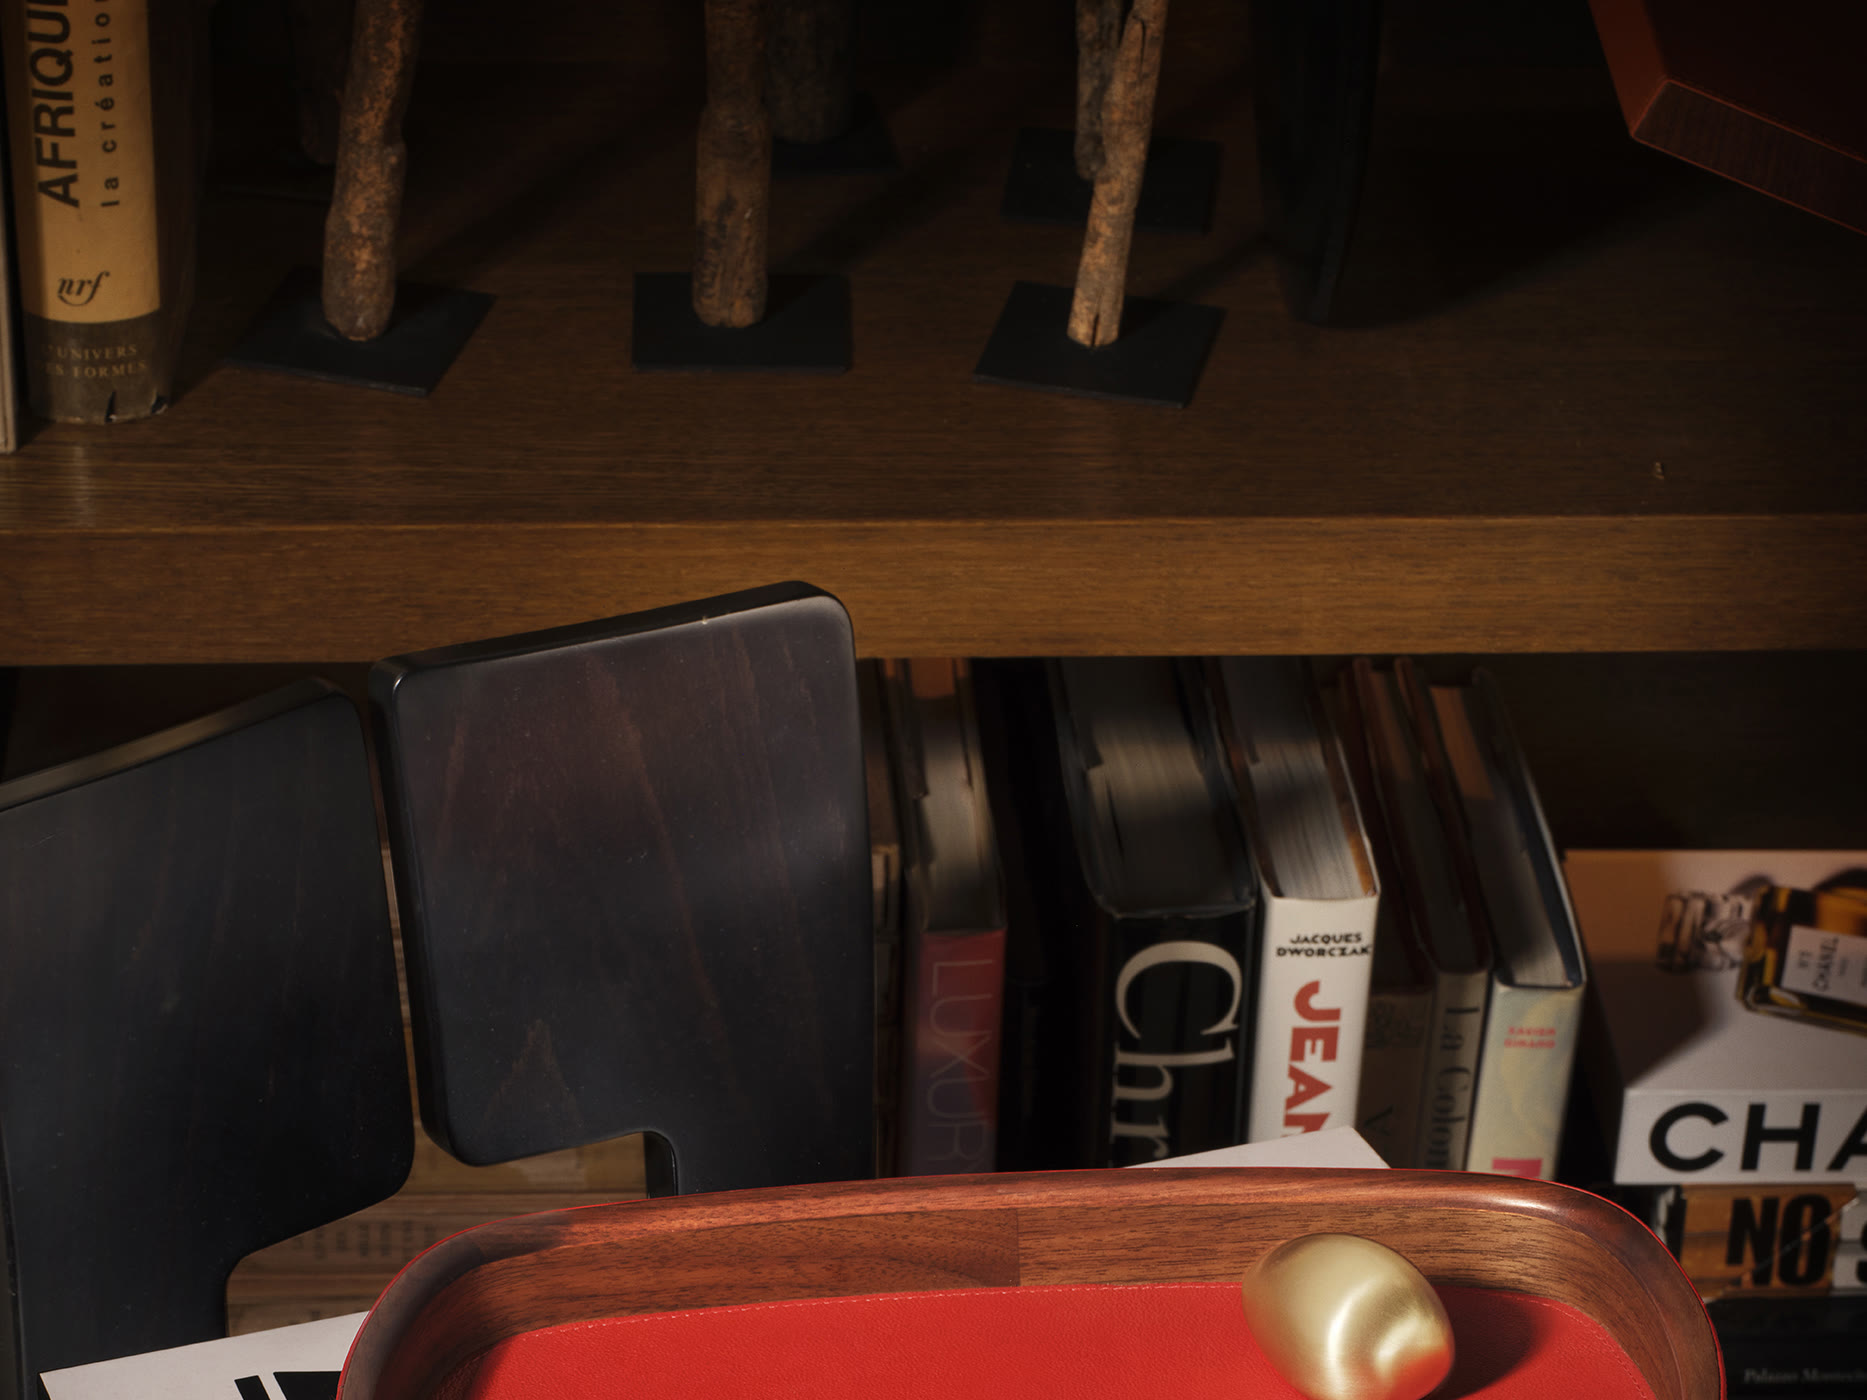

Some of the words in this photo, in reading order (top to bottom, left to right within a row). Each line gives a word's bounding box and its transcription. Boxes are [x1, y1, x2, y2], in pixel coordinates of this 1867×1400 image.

[92, 0, 117, 153] créatio
[26, 0, 79, 208] AFRIQU
[101, 176, 120, 207] la
[57, 271, 110, 307] nrf
[46, 343, 138, 362] 'UNIVERS
[1276, 944, 1370, 958] DWORCZAK
[1290, 932, 1363, 945] JACQUES
[1108, 940, 1244, 1168] Chr
[1726, 1194, 1832, 1286] NO
